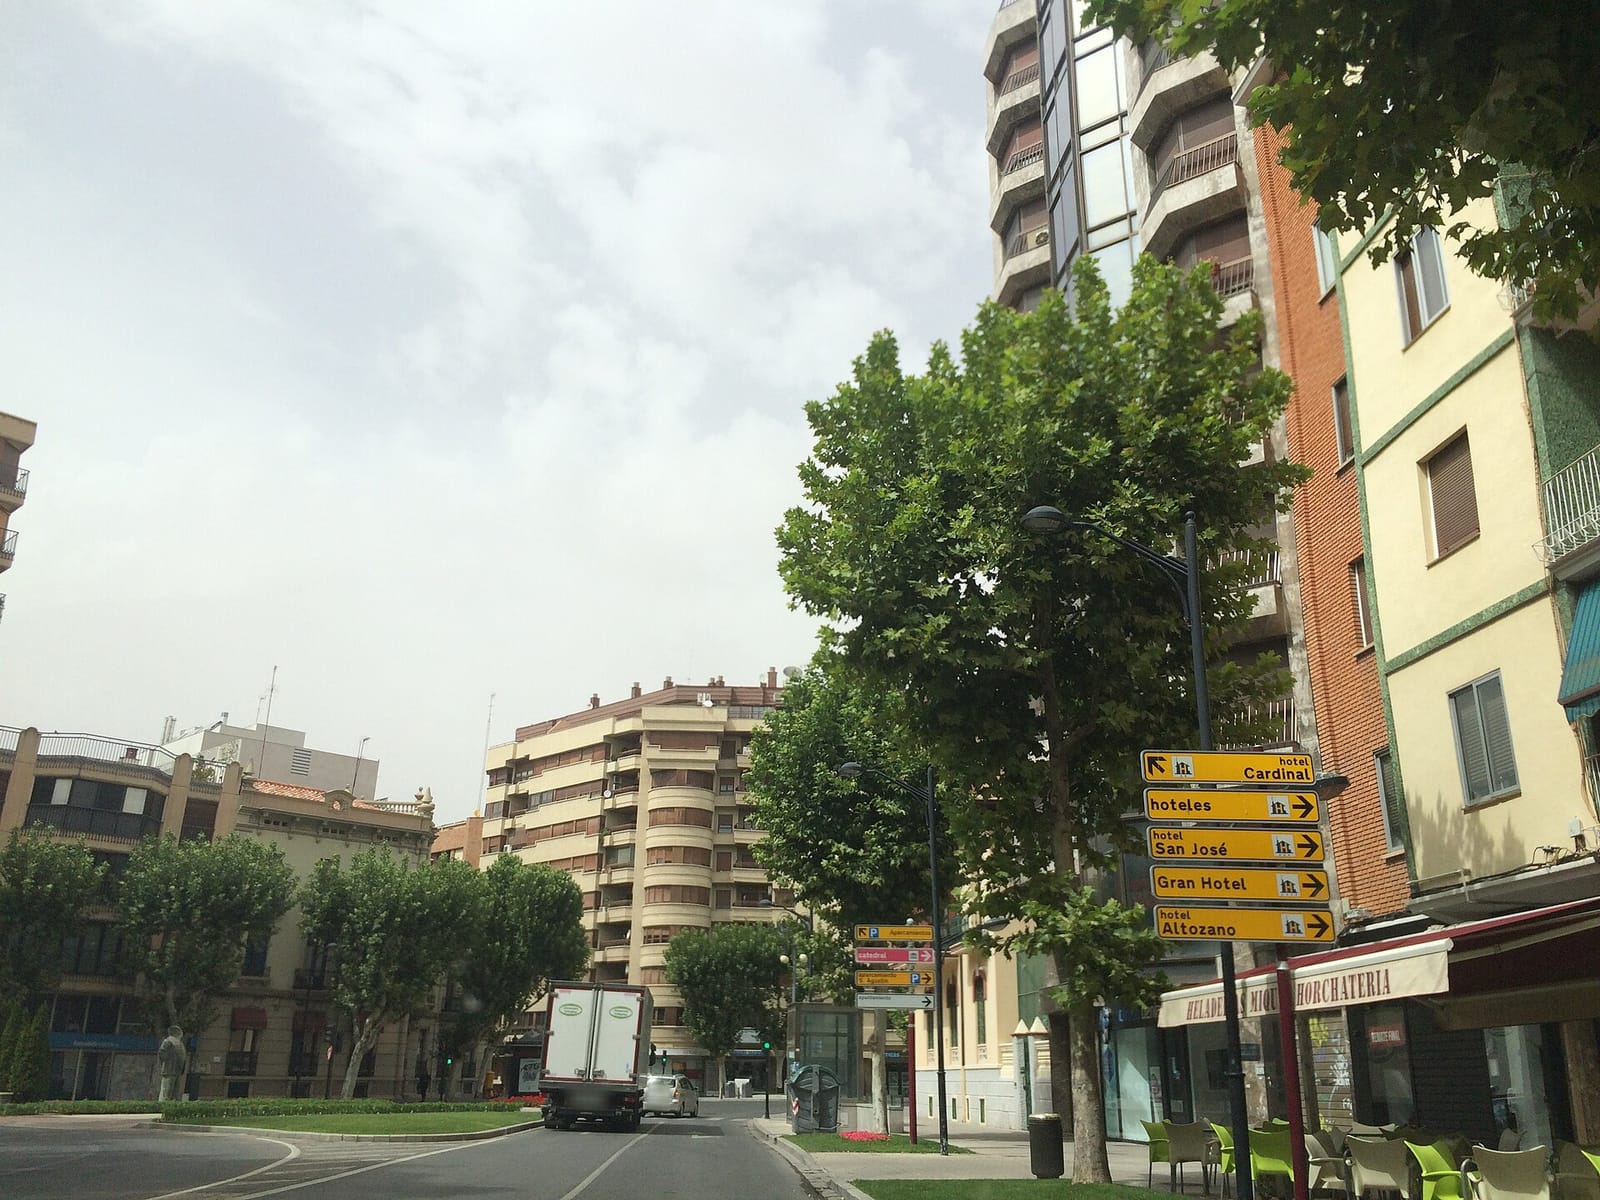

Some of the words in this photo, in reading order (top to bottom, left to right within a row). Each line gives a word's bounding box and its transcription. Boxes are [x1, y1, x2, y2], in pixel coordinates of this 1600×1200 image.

[1279, 757, 1309, 766] hotel
[1244, 767, 1311, 780] Cardinal
[1150, 798, 1212, 812] hoteles
[1153, 831, 1183, 840] hotel
[1155, 842, 1185, 855] San
[1192, 842, 1228, 856] José
[1157, 876, 1195, 889] Gran
[1201, 876, 1247, 890] Hotel
[1160, 910, 1191, 920] hotel
[870, 928, 878, 938] P
[1162, 922, 1236, 936] Altozano
[911, 974, 919, 983] P
[1296, 969, 1391, 1006] HORCHATERIA
